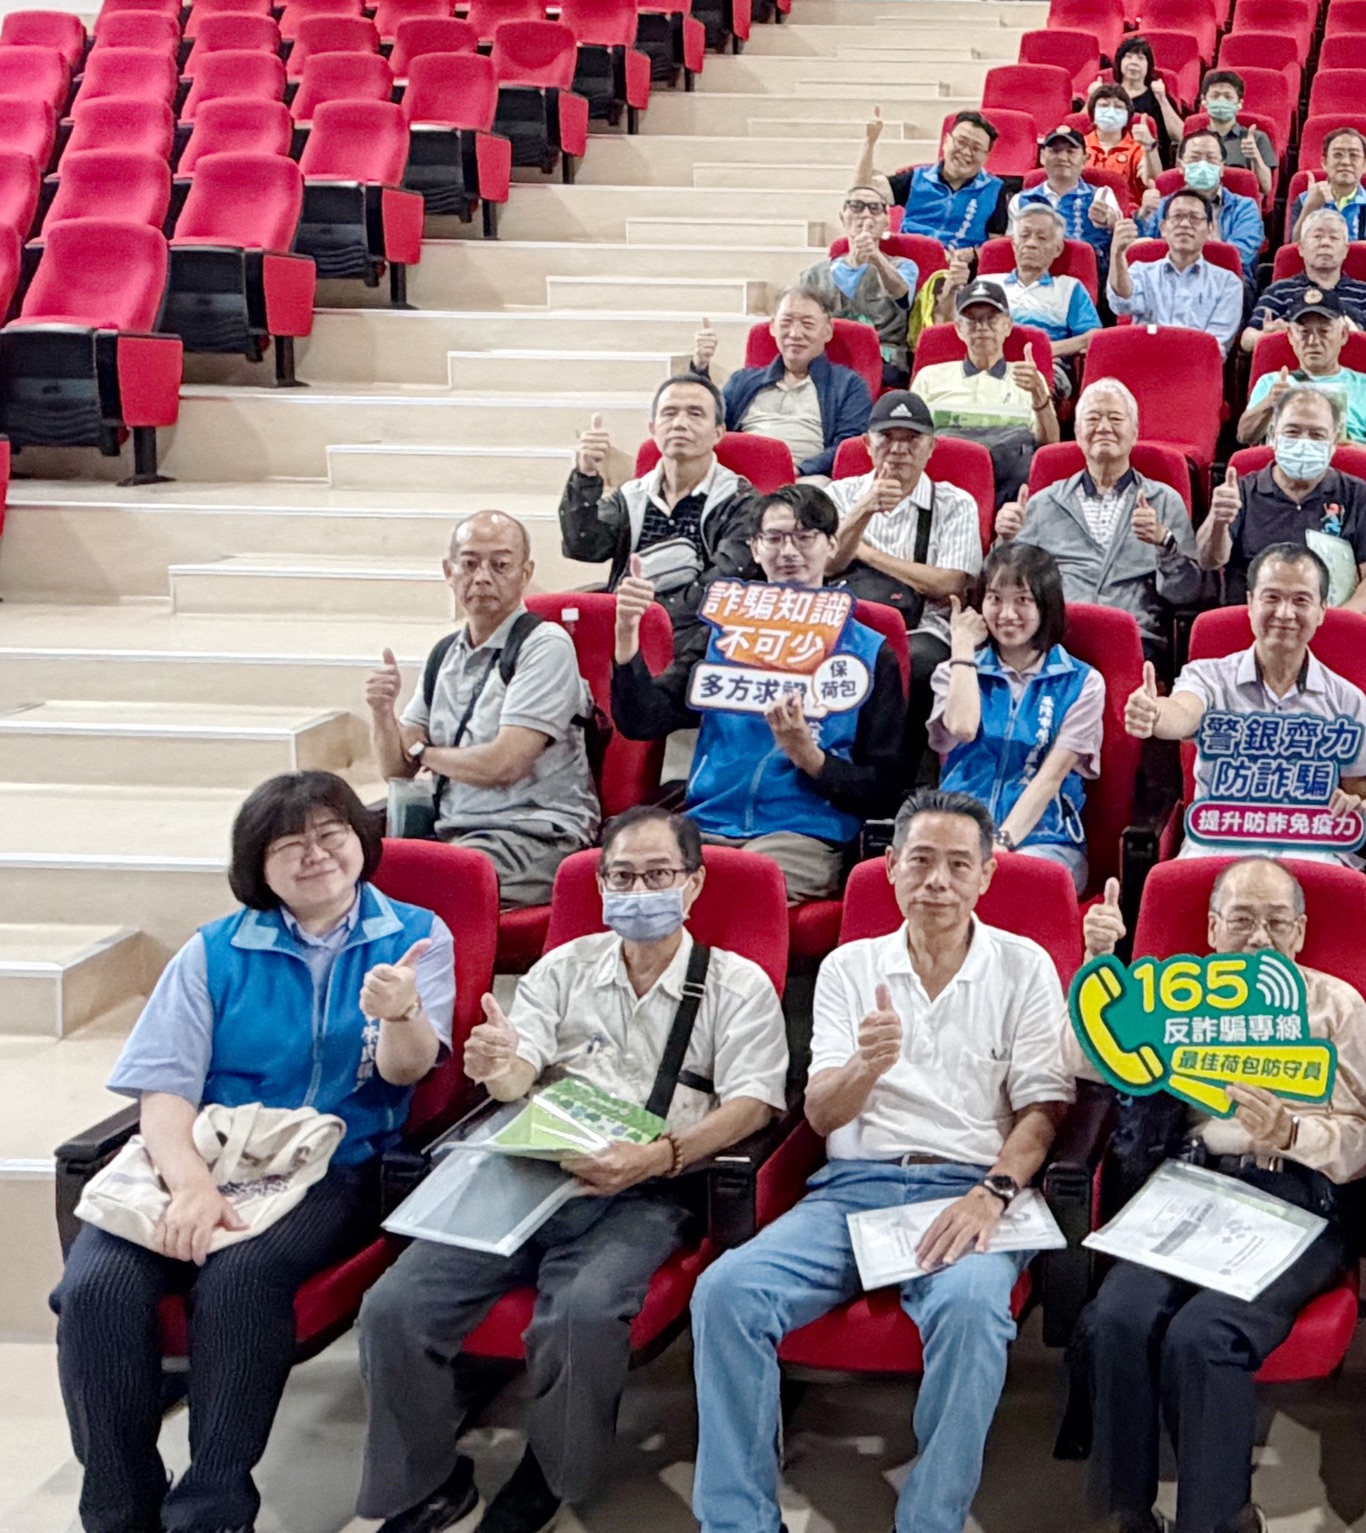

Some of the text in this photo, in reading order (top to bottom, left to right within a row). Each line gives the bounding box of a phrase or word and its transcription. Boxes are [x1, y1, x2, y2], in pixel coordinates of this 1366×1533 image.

[702, 580, 852, 627] 詐騙知識
[715, 625, 825, 664] 不可少
[830, 660, 848, 678] 保
[821, 680, 857, 699] 荷包
[1202, 714, 1361, 758] 警銀齊力
[1212, 758, 1335, 800] 防詐騙
[1198, 810, 1357, 836] 提升防詐免疫力
[1133, 960, 1249, 1013] 165
[1164, 1013, 1302, 1044] 反詐騙專線
[1177, 1050, 1323, 1081] 最佳荷包防守員
